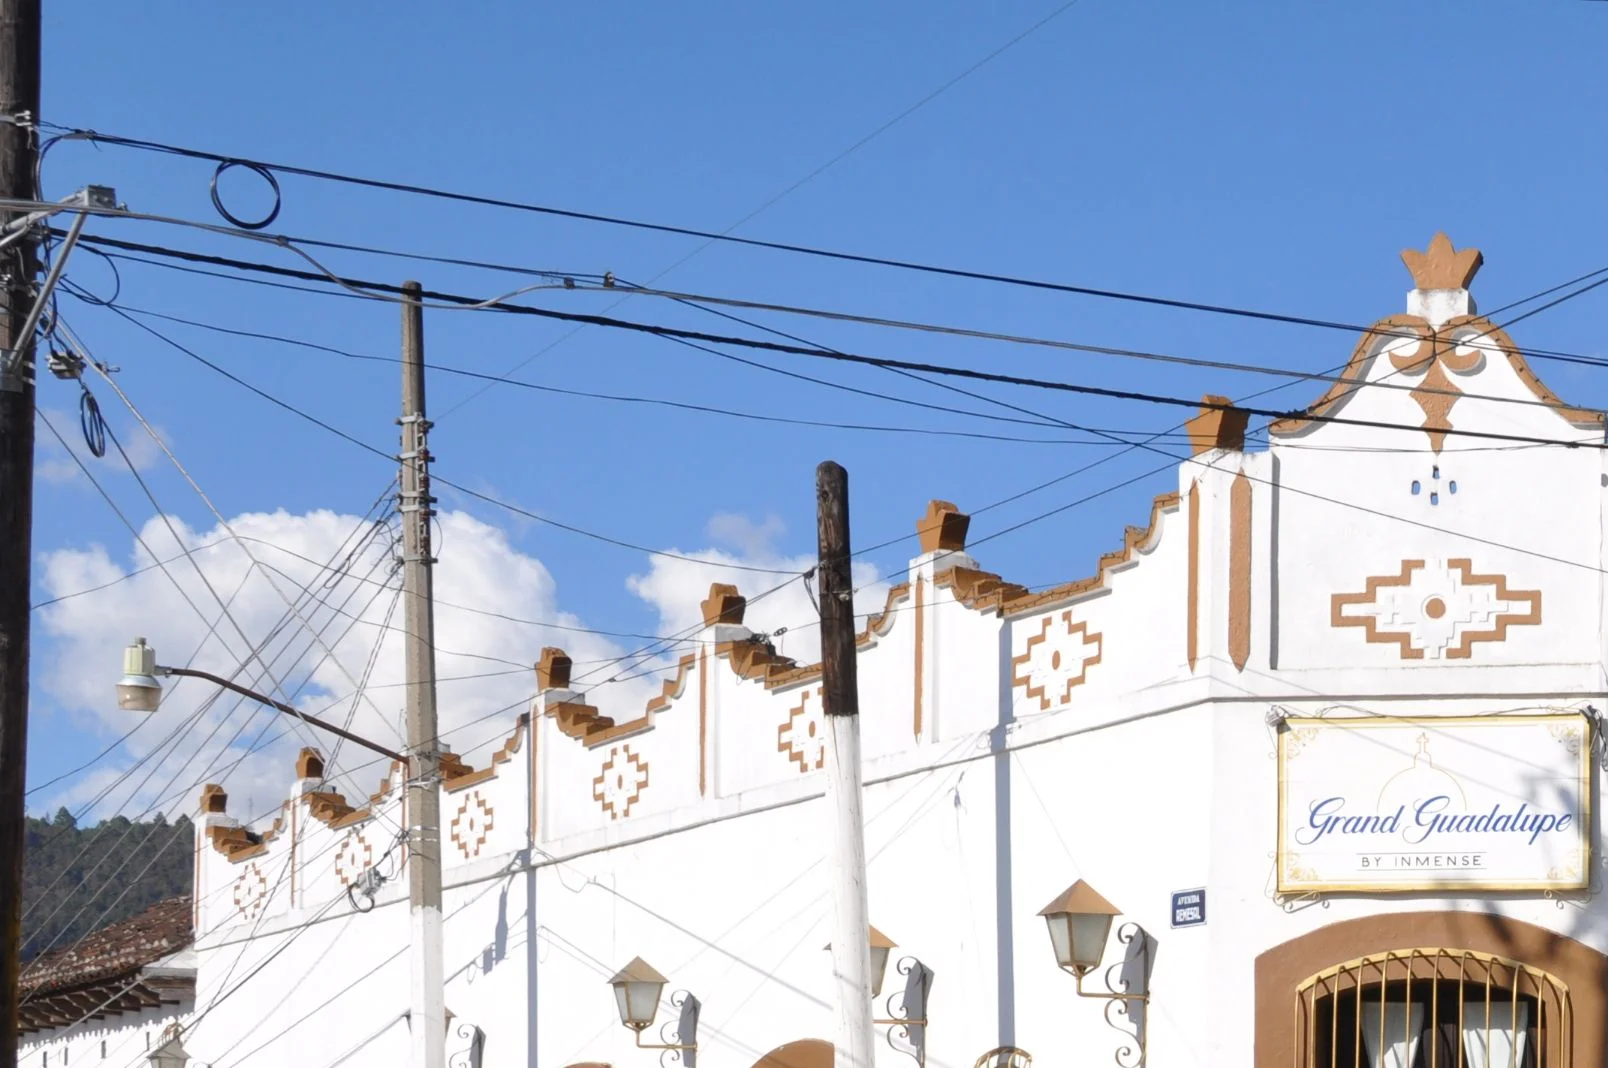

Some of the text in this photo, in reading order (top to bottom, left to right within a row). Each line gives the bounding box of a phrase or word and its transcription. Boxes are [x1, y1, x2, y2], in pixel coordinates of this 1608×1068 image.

[1295, 795, 1572, 845] Grand Guadalupe
[1361, 855, 1482, 868] BY INMENSE
